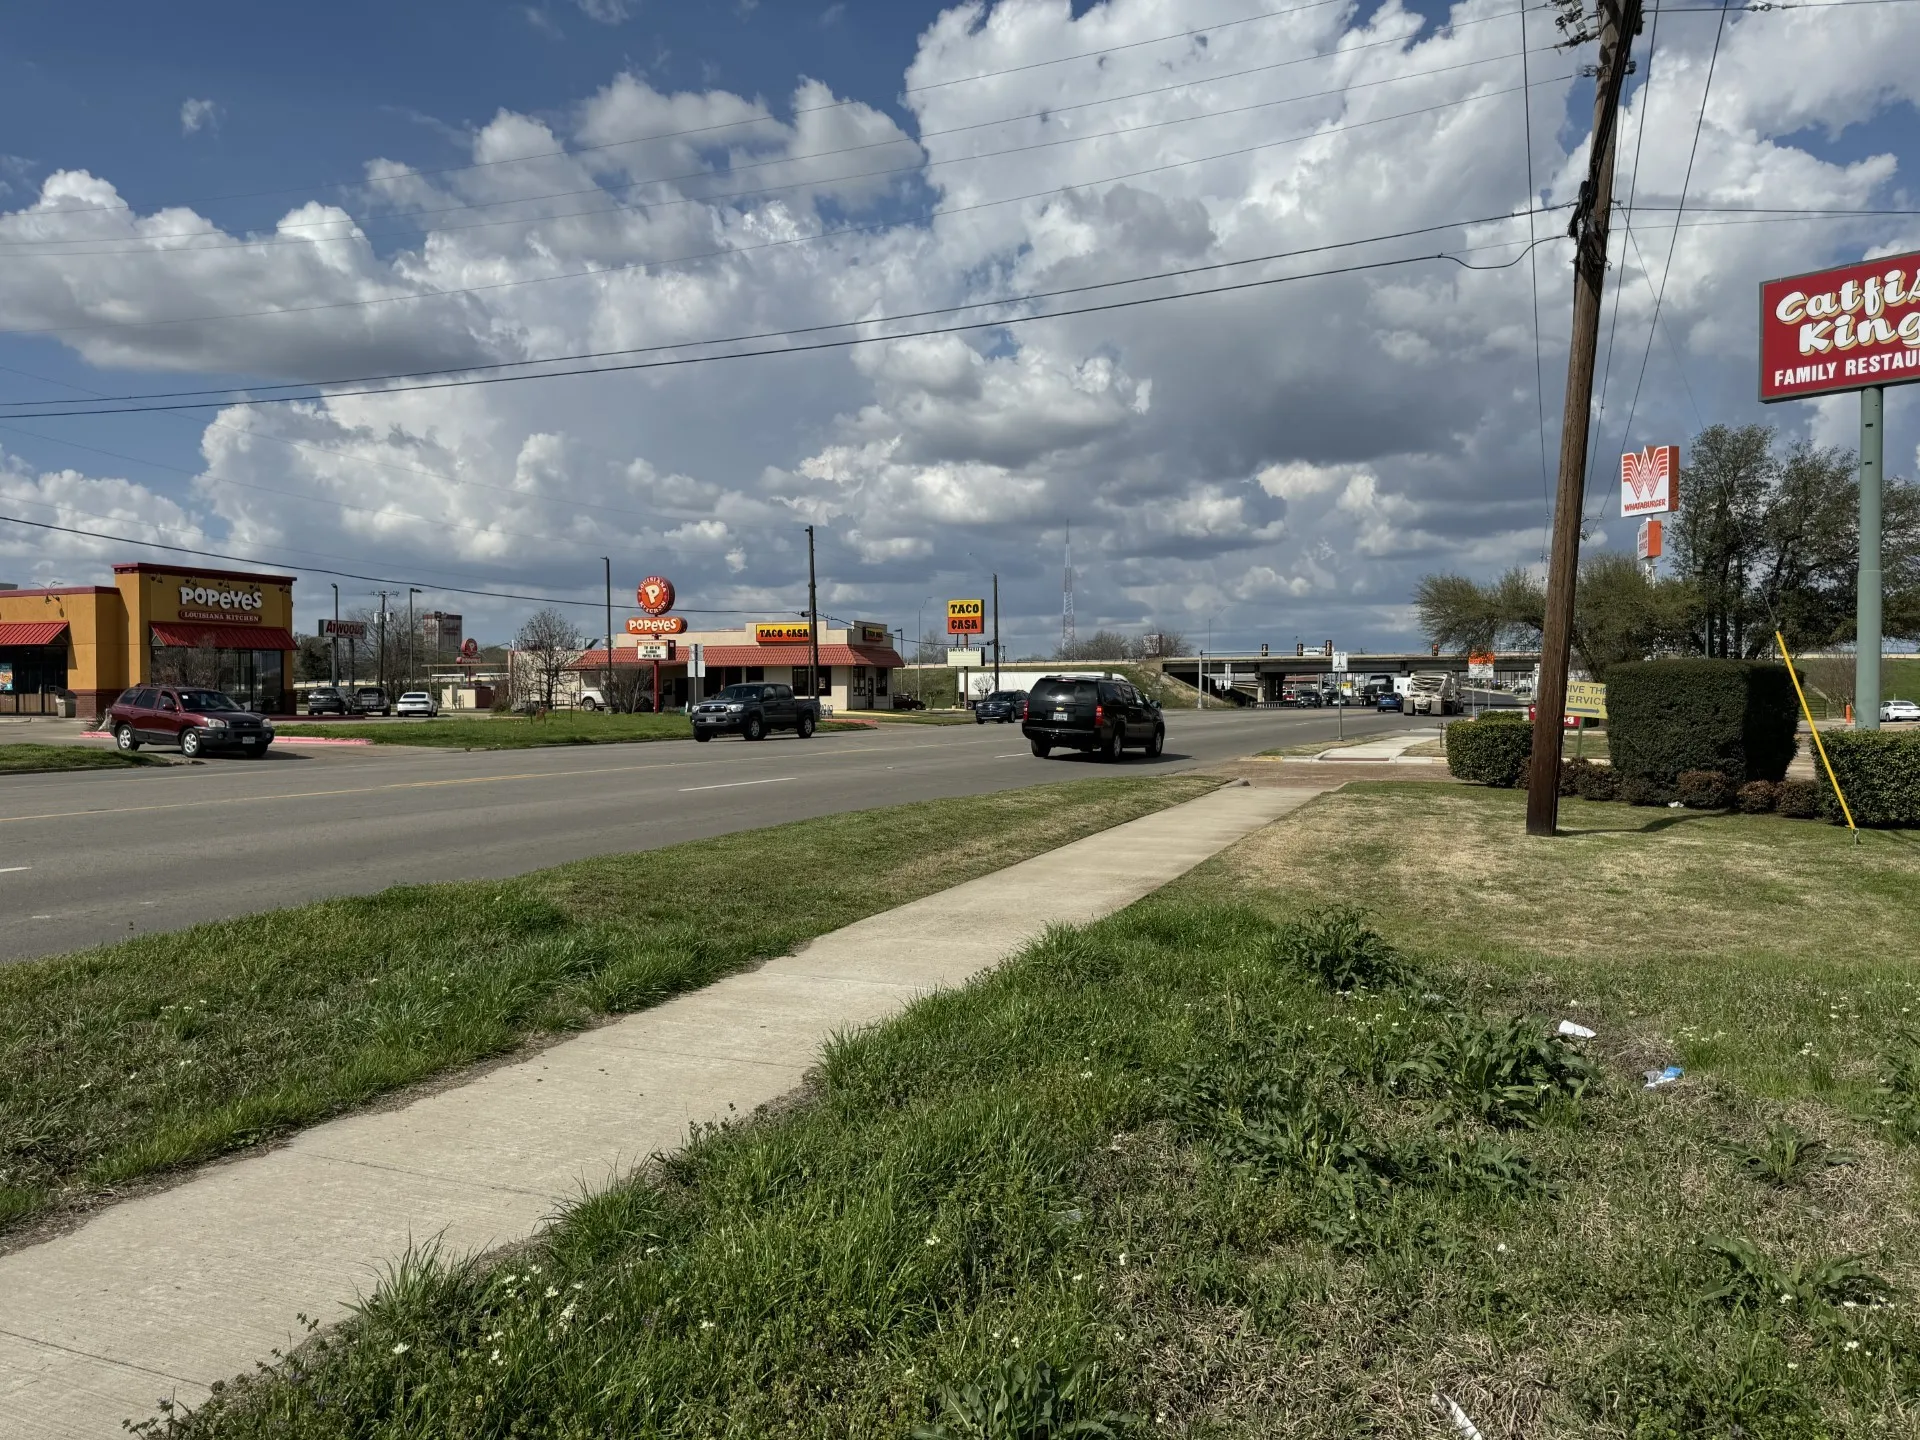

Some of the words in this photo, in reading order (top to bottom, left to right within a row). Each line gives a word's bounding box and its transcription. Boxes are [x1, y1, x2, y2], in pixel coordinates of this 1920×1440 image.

[1799, 311, 1920, 356] King
[1774, 361, 1838, 388] FAMILY
[1845, 349, 1920, 377] RESTAU
[1624, 498, 1666, 512] WHATABURGER
[950, 603, 980, 614] TACO
[183, 611, 224, 621] LOUISIANA
[225, 614, 260, 622] KITCHEN
[951, 619, 978, 630] CASA
[759, 628, 783, 638] TACO
[786, 628, 809, 638] CASA
